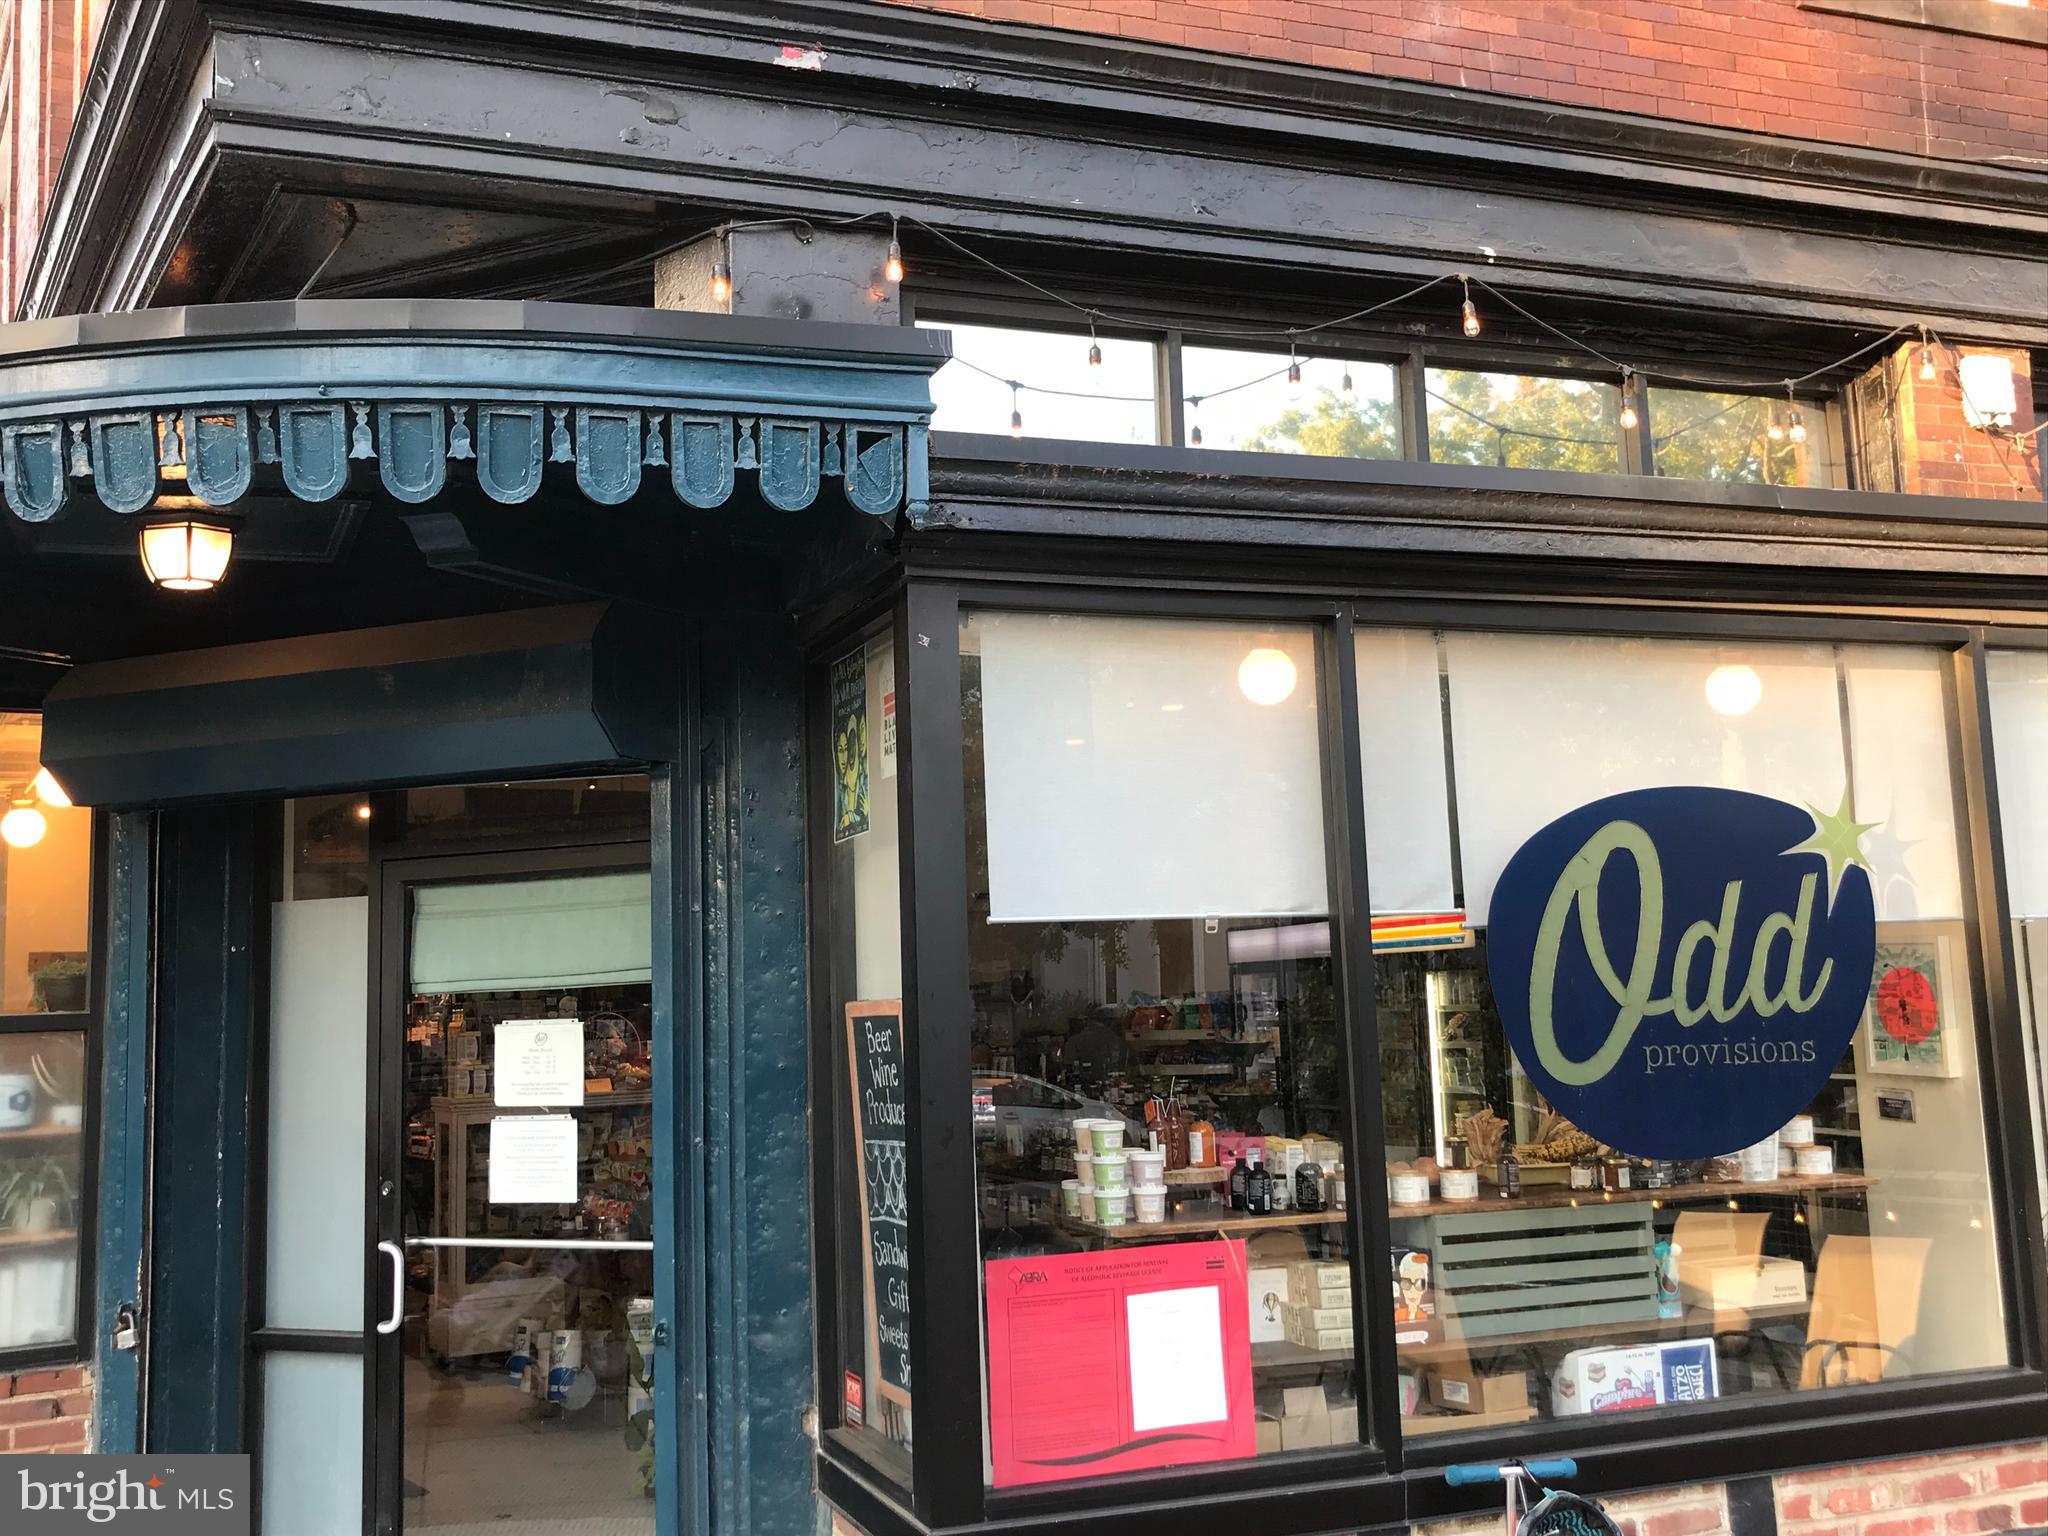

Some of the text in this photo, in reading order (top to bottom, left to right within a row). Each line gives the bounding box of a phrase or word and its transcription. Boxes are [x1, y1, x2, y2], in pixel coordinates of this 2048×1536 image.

[1529, 819, 1834, 1086] Odd
[864, 1020, 892, 1054] Beer
[1643, 1036, 1817, 1074] provisions
[869, 1059, 899, 1089] Wine
[879, 1316, 909, 1351] Sweets
[1676, 1364, 1692, 1401] ATZO
[1686, 1364, 1705, 1400] OJECT
